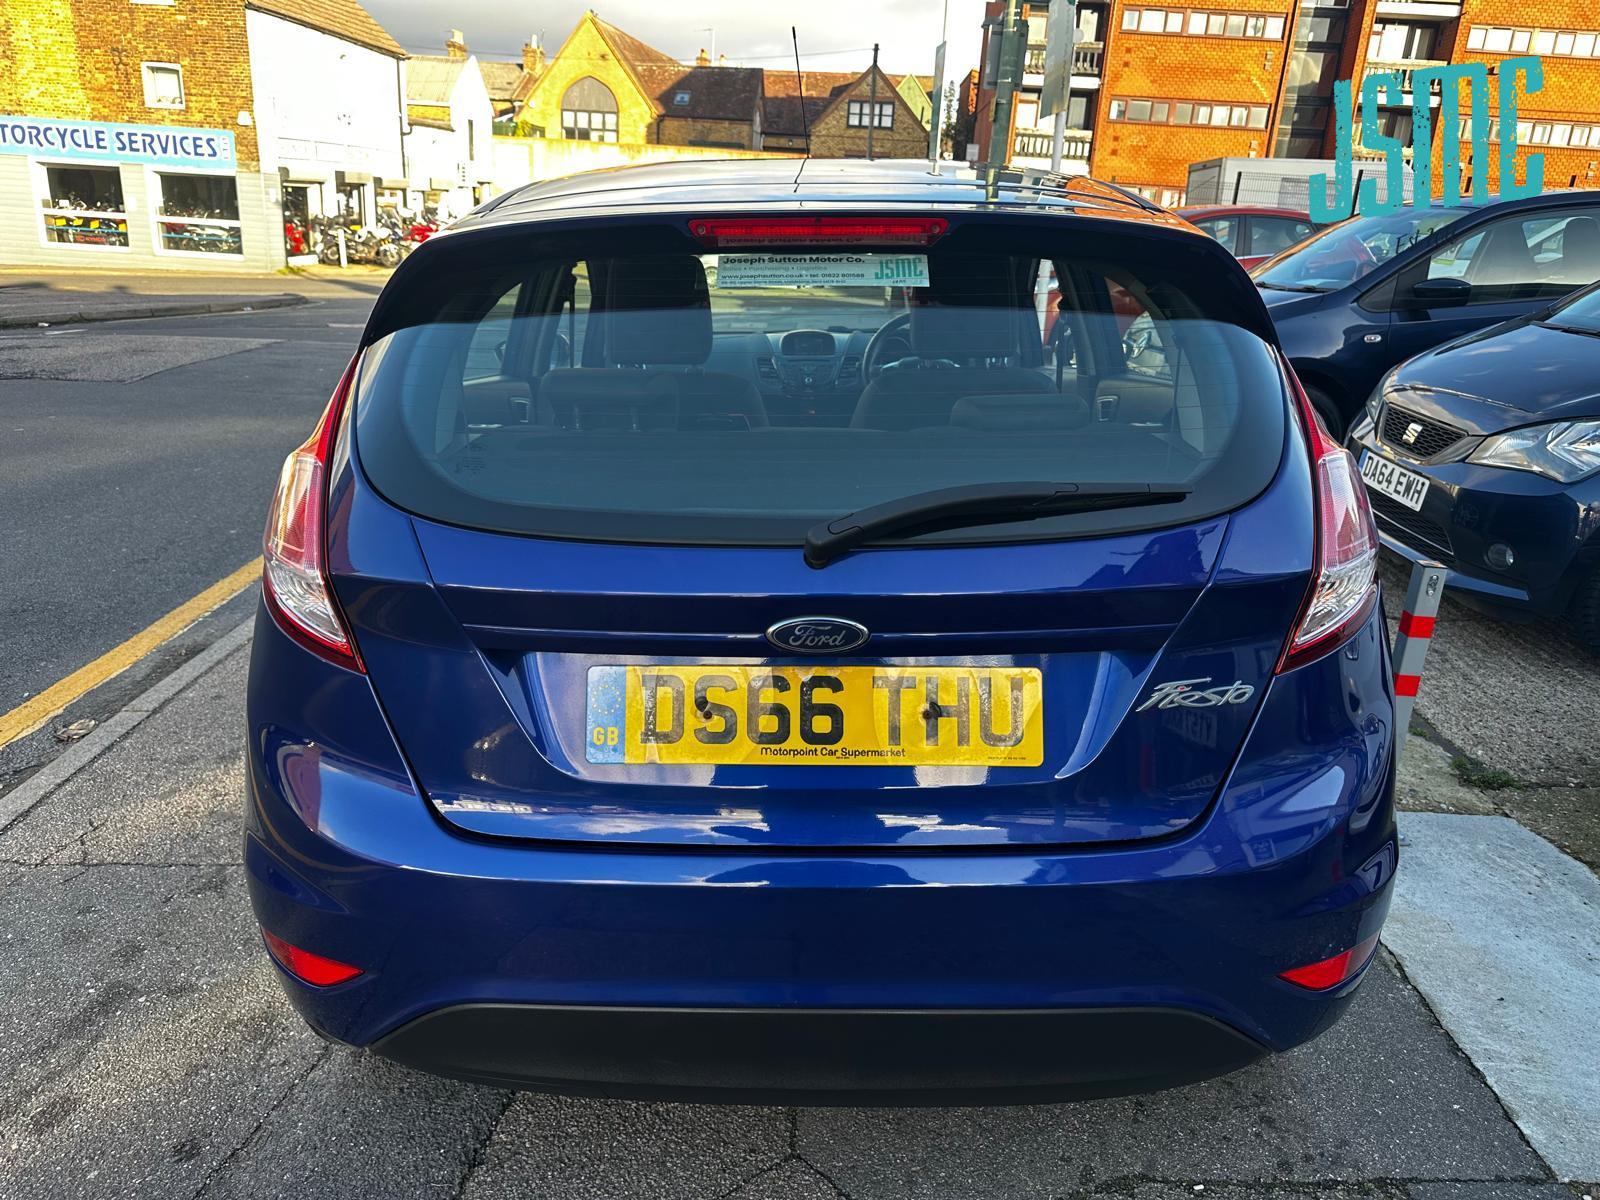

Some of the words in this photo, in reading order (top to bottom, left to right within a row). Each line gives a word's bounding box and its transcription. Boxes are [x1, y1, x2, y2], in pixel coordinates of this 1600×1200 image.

[0, 123, 107, 149] TORCYCLE
[115, 131, 218, 158] SERVICES
[723, 256, 765, 265] Joseph
[874, 257, 923, 279] JSMC
[1363, 455, 1395, 489] DA64
[1393, 471, 1425, 504] EWH
[789, 624, 846, 646] Ford
[1135, 677, 1255, 712] Fiesta
[640, 674, 844, 745] DS66
[873, 675, 1024, 747] THU
[593, 726, 619, 746] GB
[760, 747, 817, 757] Motorpoint
[820, 747, 839, 756] Car
[841, 747, 906, 758] Supermarket
